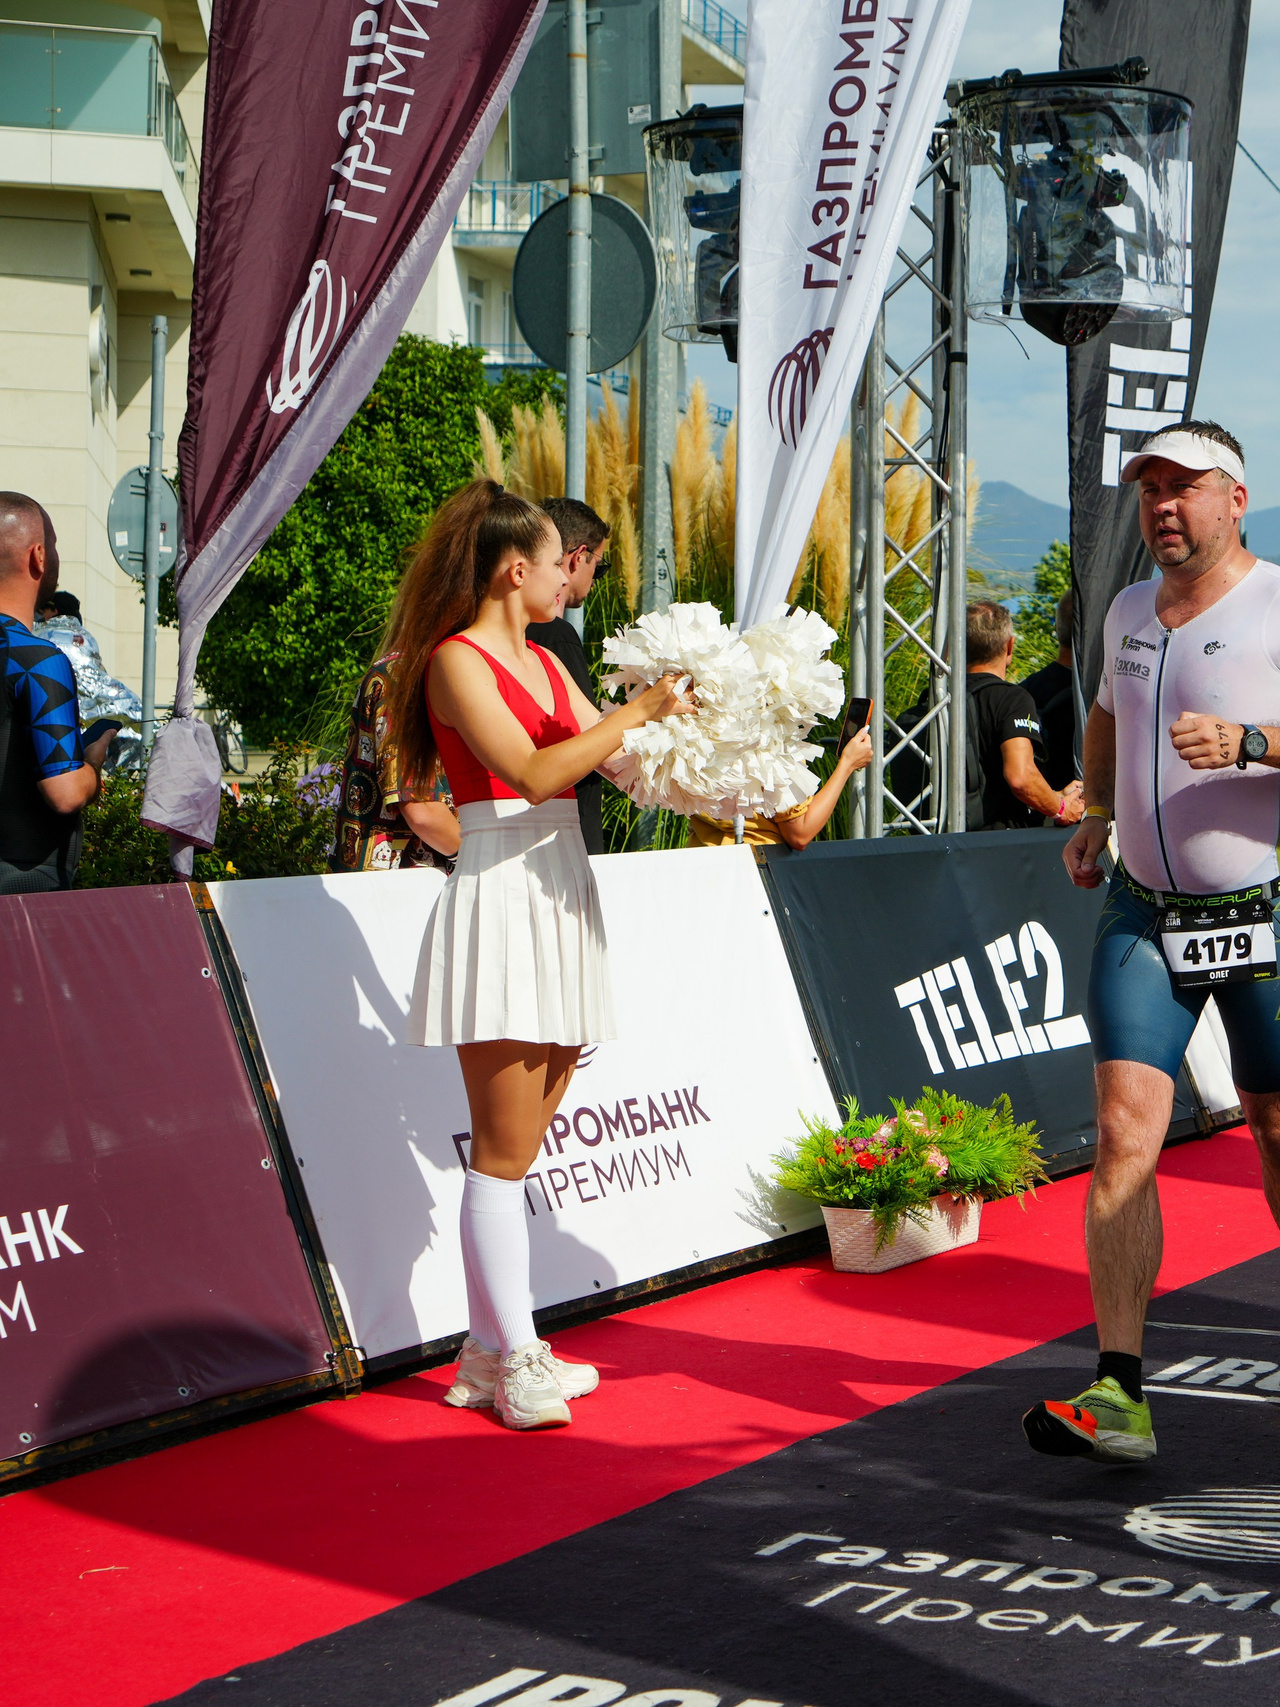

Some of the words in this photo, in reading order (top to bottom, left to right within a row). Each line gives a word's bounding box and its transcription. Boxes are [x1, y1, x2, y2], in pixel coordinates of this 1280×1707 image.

[325, 0, 389, 216] ГАЗПР
[1215, 724, 1229, 759] 4179
[1165, 888, 1262, 907] POWERUP
[1165, 918, 1181, 926] STAR
[1183, 932, 1252, 965] 4179
[1209, 970, 1230, 979] ОЛЕГ
[894, 921, 1091, 1075] TELE2
[525, 1140, 691, 1215] ПРЕМИУМ
[0, 1204, 84, 1270] НК
